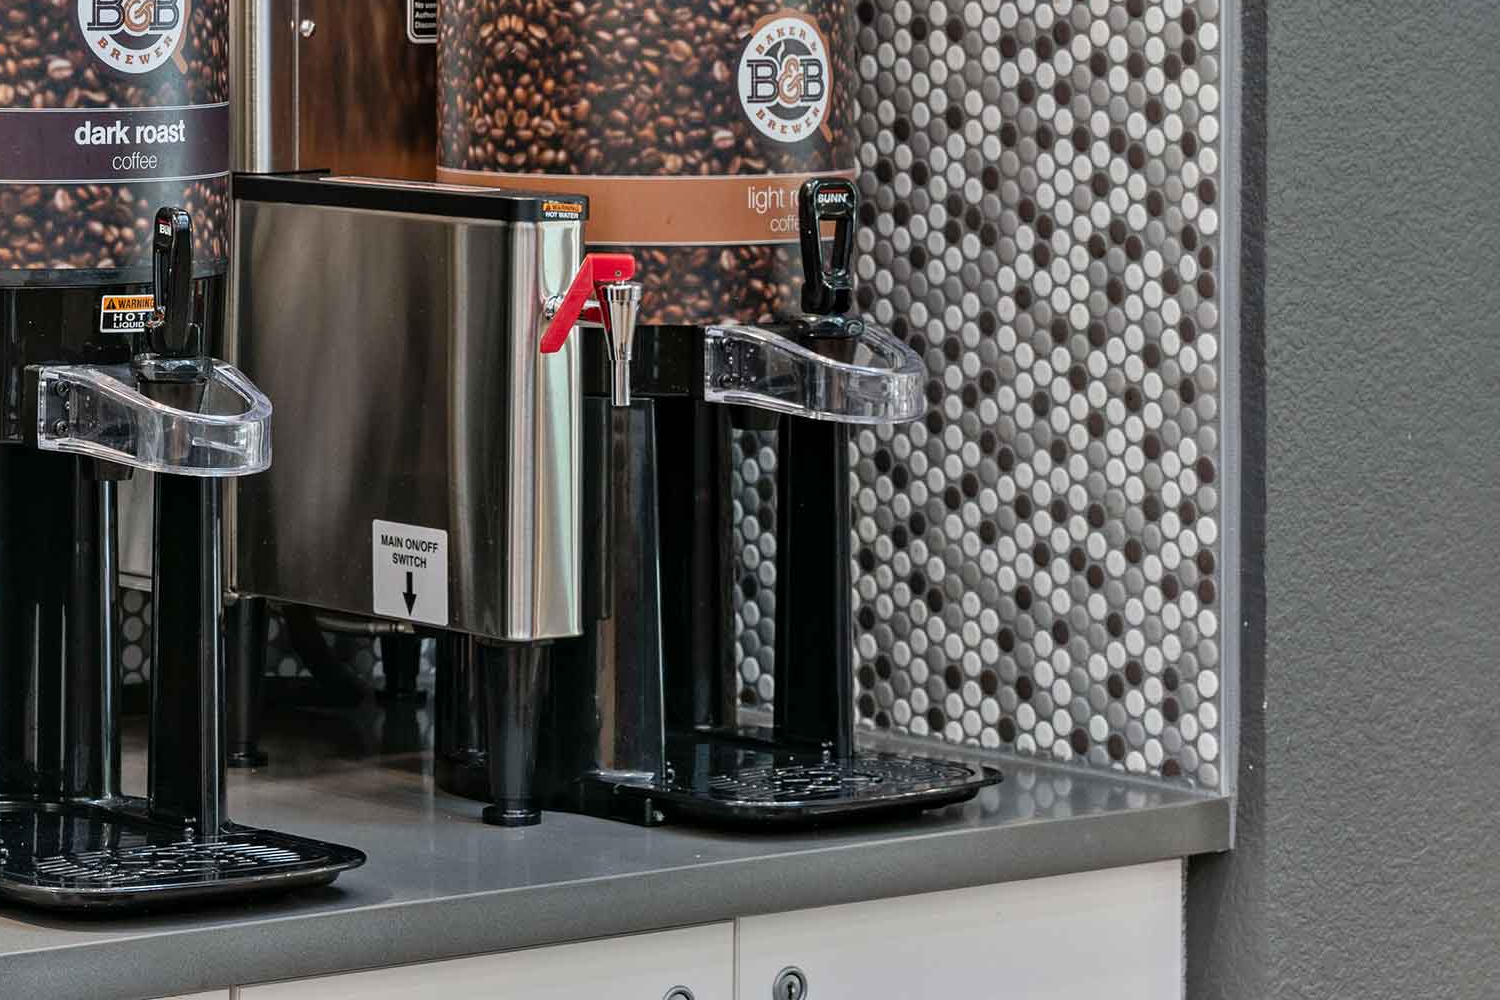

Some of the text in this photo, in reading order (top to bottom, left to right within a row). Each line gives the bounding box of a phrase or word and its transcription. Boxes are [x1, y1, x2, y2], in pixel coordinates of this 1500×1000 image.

[98, 35, 173, 65] BREWER
[756, 26, 808, 55] BAKER
[746, 57, 825, 104] B&B
[74, 119, 186, 145] dark roast
[756, 106, 820, 135] BREWER
[112, 151, 158, 170] coffee
[747, 185, 785, 214] light
[113, 312, 146, 321] HOT
[113, 321, 145, 329] LIQUID
[381, 534, 438, 552] MAIN ON/OFF
[392, 552, 427, 568] SWITCH
